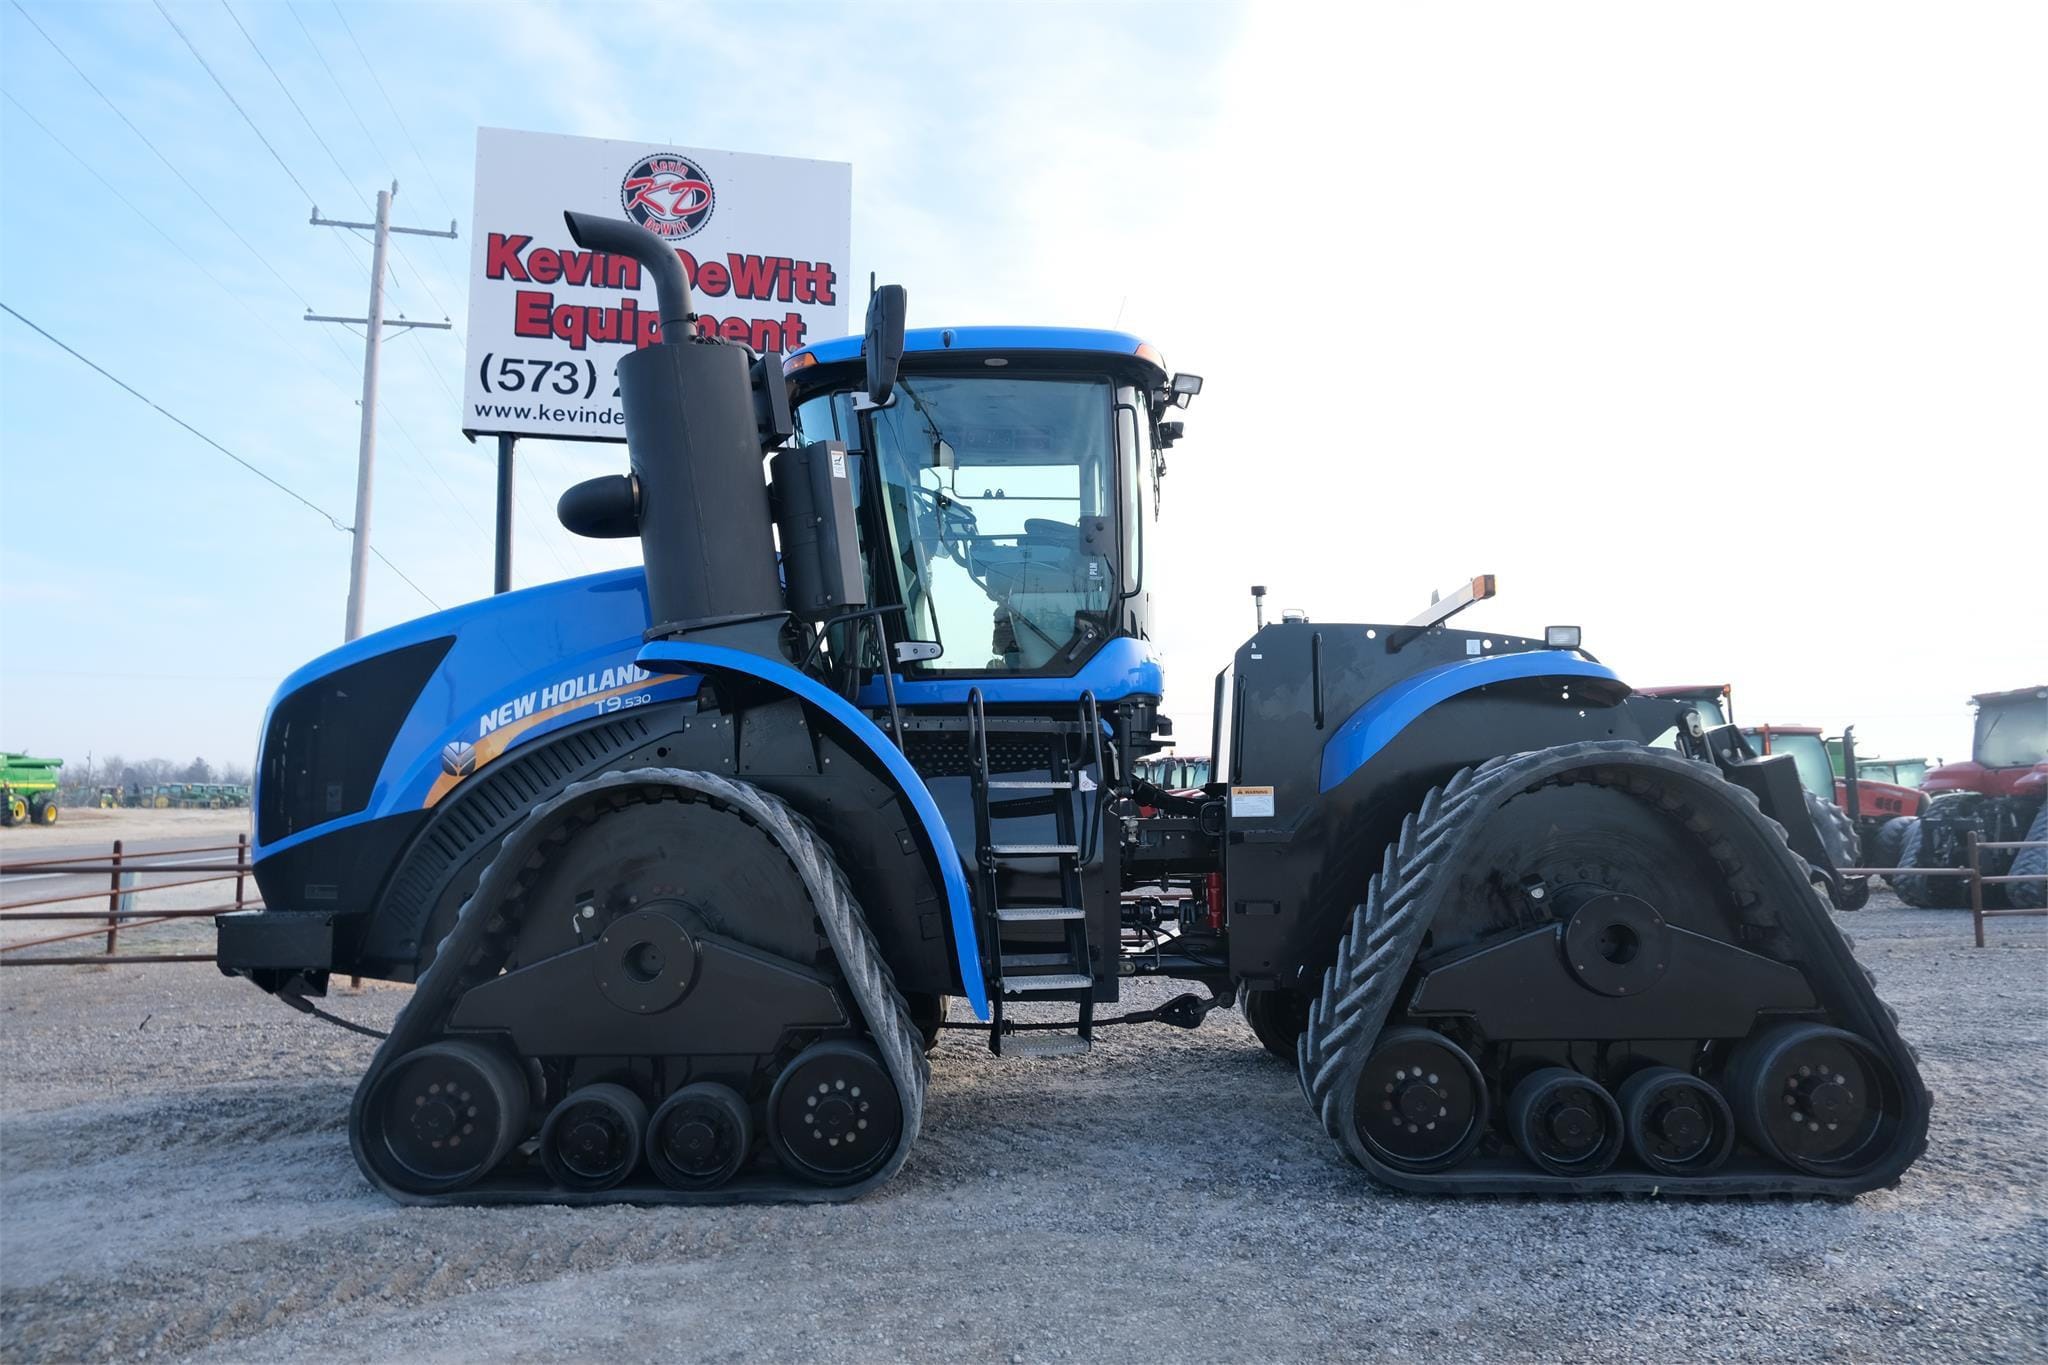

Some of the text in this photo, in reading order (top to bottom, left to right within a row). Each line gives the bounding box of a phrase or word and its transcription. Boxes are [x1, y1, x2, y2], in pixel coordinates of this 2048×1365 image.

[649, 160, 688, 176] Kevin
[624, 177, 712, 216] KD
[644, 217, 690, 235] DeWitt
[486, 232, 641, 291] Kevin
[479, 352, 597, 399] (573)
[479, 663, 650, 738] NEW HOLLAND
